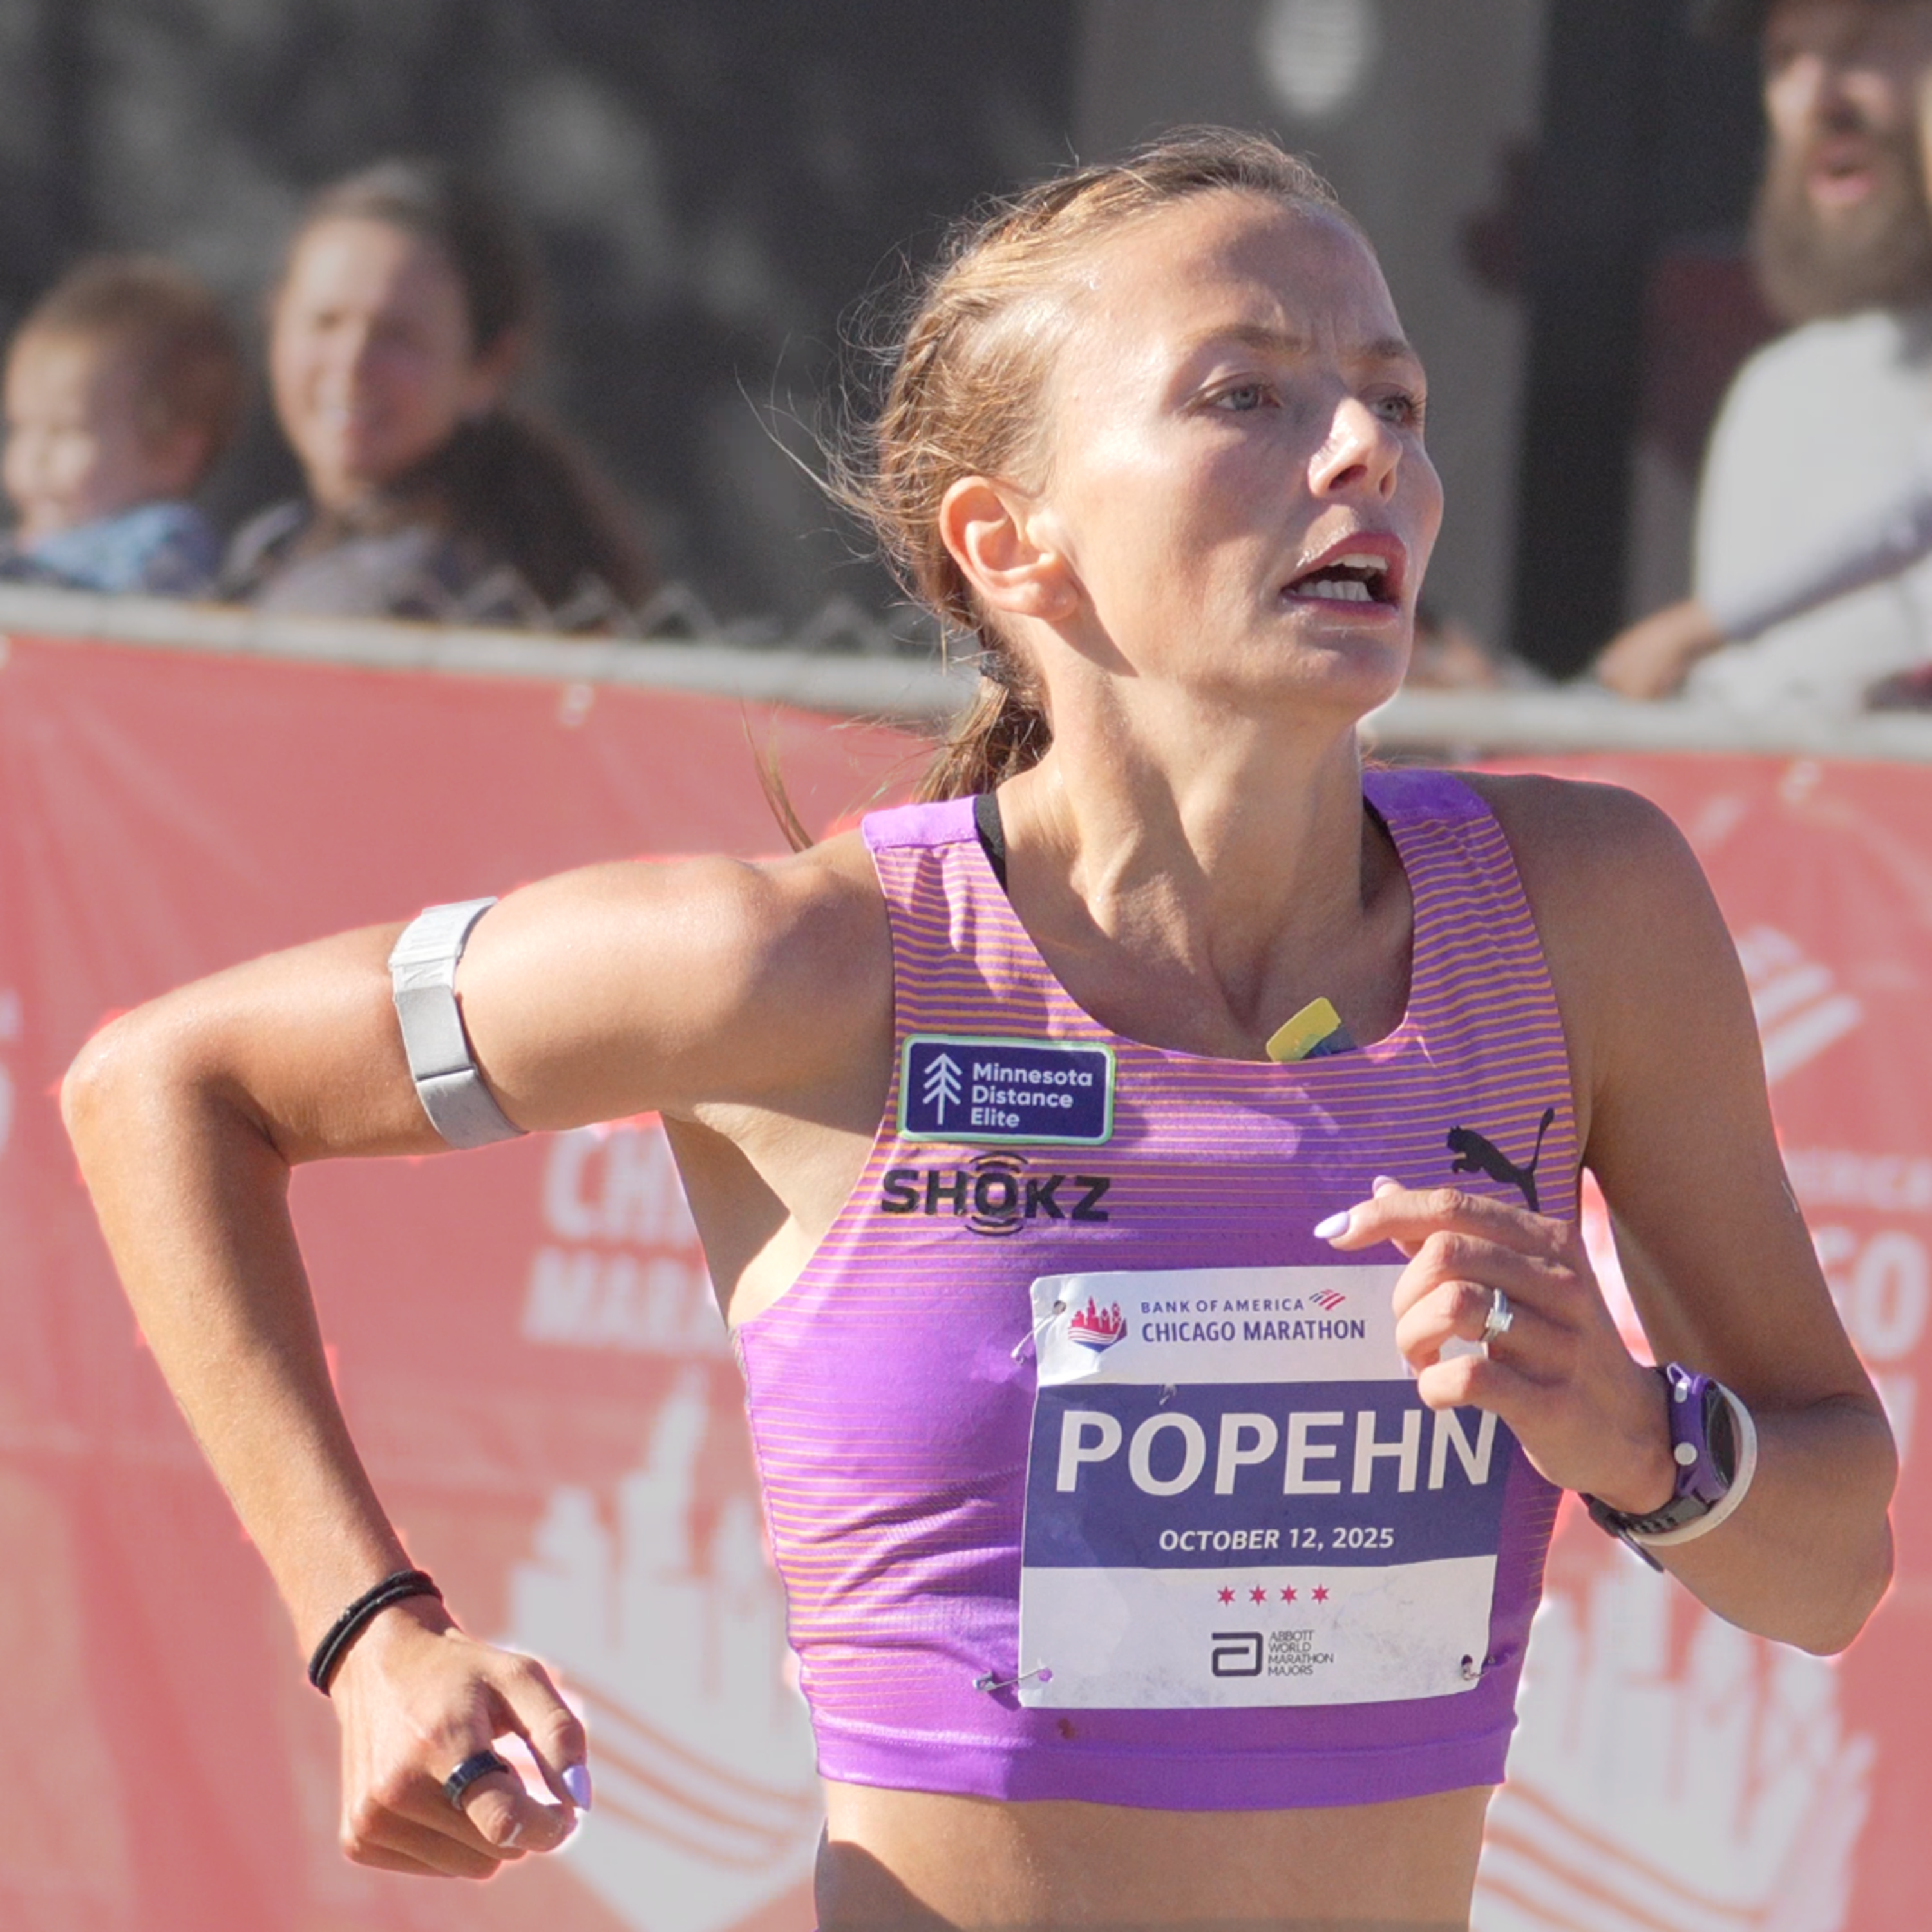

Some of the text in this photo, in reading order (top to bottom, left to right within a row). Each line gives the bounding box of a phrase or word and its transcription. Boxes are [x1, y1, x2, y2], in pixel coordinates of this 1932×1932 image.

[972, 1062, 1094, 1086] Minnesota
[971, 1085, 1074, 1108] Distance
[971, 1107, 1021, 1128] Elite
[880, 1167, 1111, 1223] SHOKZ
[1141, 1298, 1305, 1314] BANK OF AMERICA
[1142, 1319, 1366, 1343] CHICAGO MARATHON
[1056, 1408, 1499, 1497] POPEHN
[1159, 1527, 1394, 1551] OCTOBER 12, 2025
[1269, 1630, 1315, 1642] ABBOTT
[1268, 1642, 1312, 1654] WORLD
[1268, 1653, 1334, 1665] MARATHON
[1268, 1664, 1314, 1676] MAJORS
